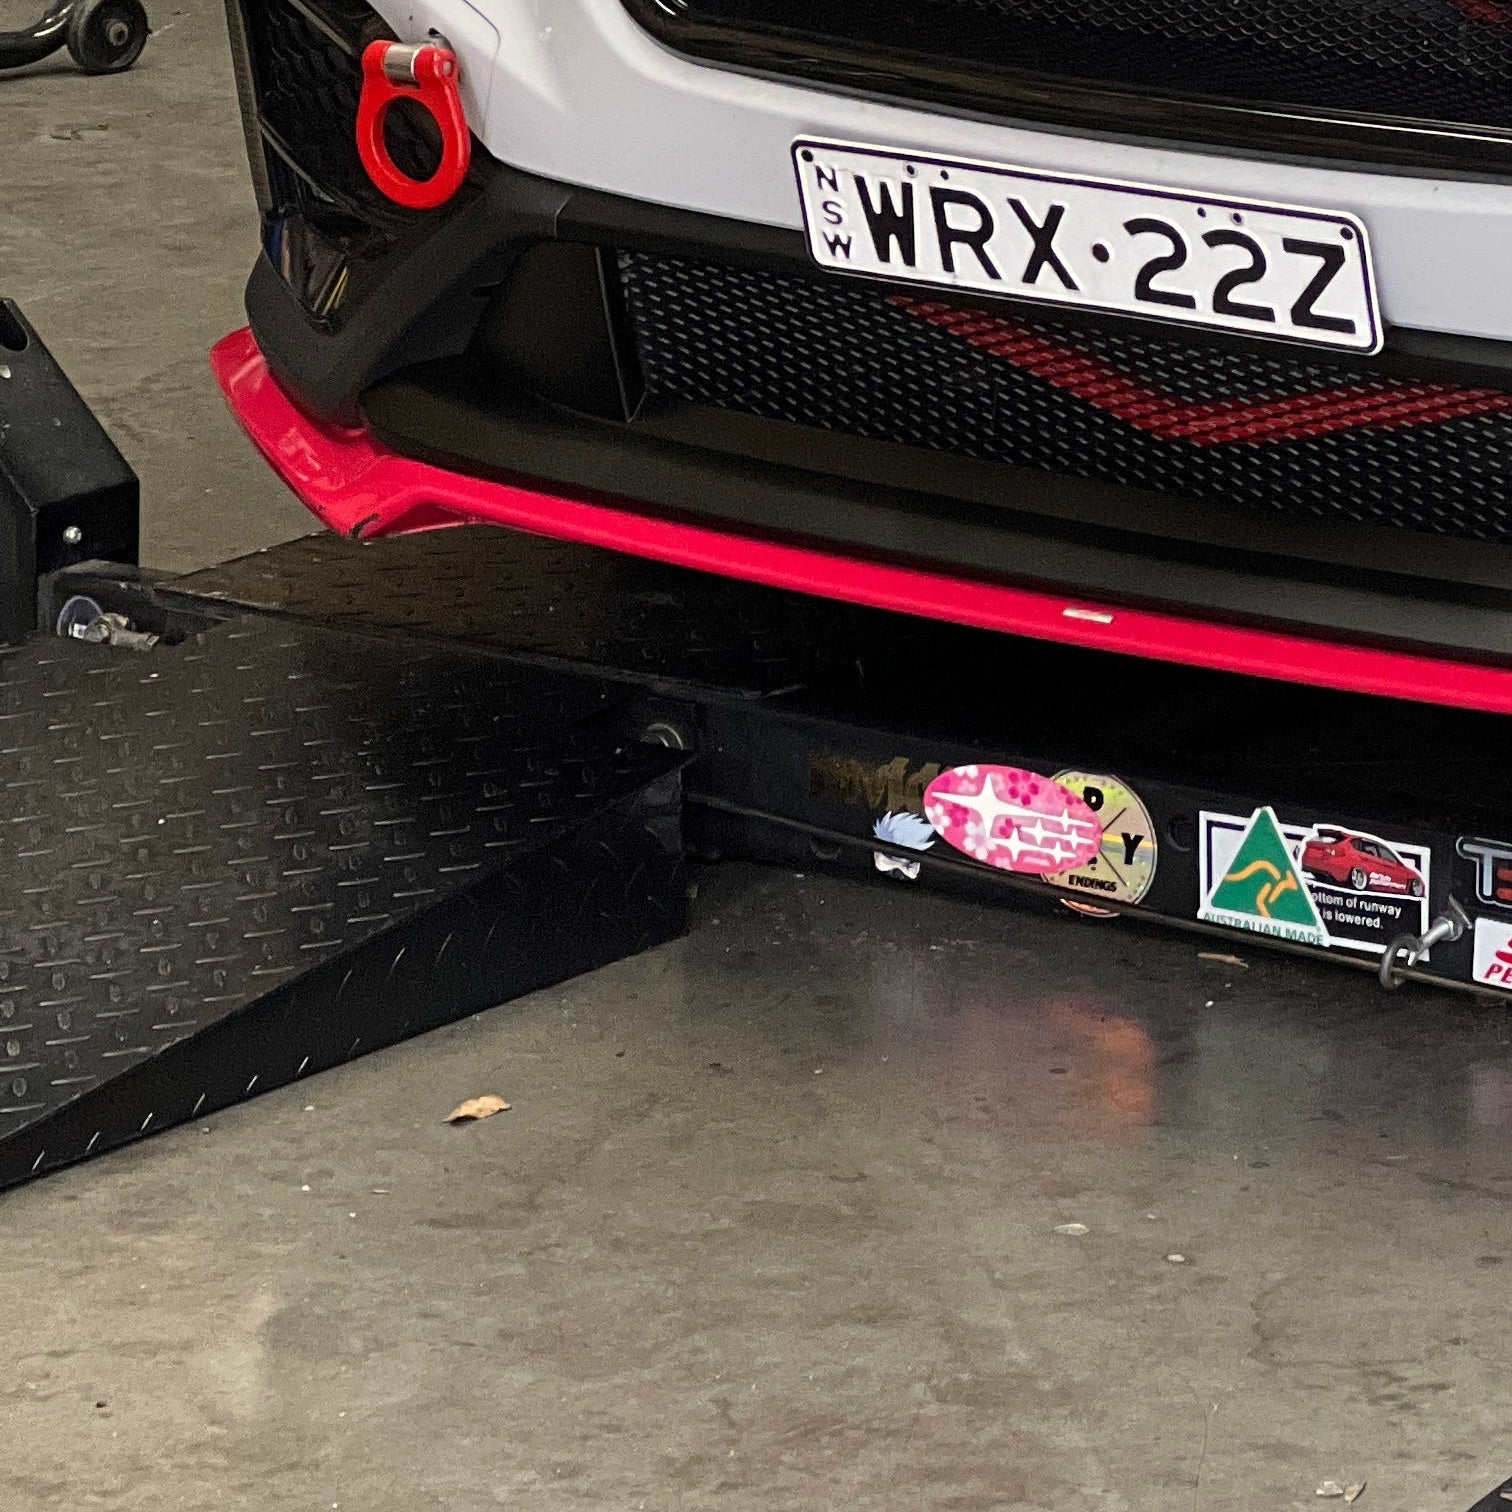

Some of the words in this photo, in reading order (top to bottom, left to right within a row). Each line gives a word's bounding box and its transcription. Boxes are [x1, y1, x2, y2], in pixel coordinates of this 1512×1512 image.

[1121, 832, 1145, 865] Y
[1068, 874, 1118, 892] ENDINGS
[1311, 891, 1344, 907] ottom
[1345, 896, 1358, 908] of
[1360, 899, 1402, 919] runway
[1335, 908, 1384, 929] lowered.
[1203, 912, 1283, 937] AUSTRALIAN
[1285, 928, 1325, 946] MADE
